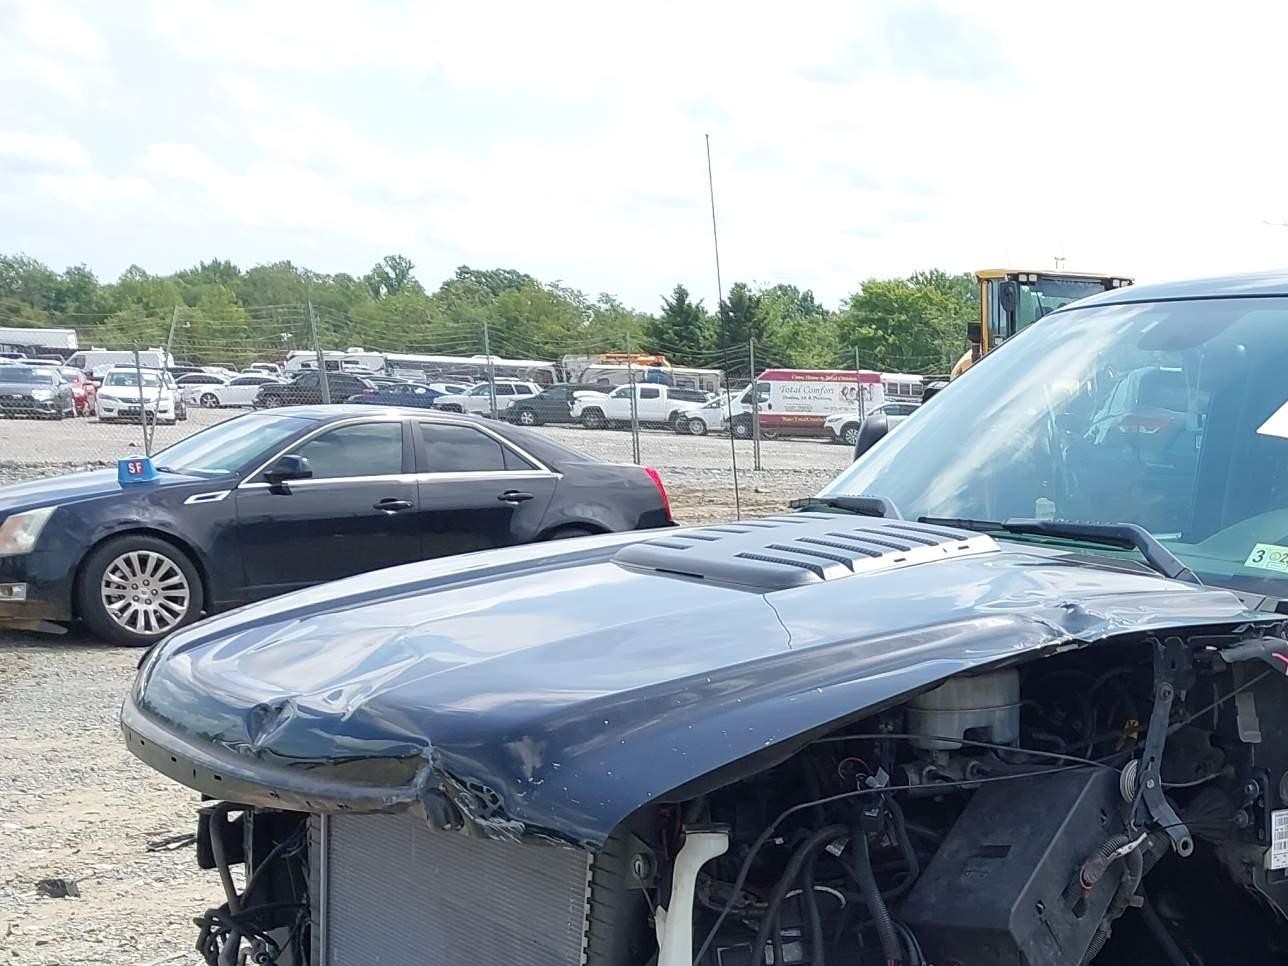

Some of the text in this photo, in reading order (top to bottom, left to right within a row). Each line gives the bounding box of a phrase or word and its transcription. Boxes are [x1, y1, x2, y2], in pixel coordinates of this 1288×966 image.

[780, 384, 834, 397] Total Comfort
[128, 462, 142, 474] SF
[1252, 549, 1266, 563] 3
